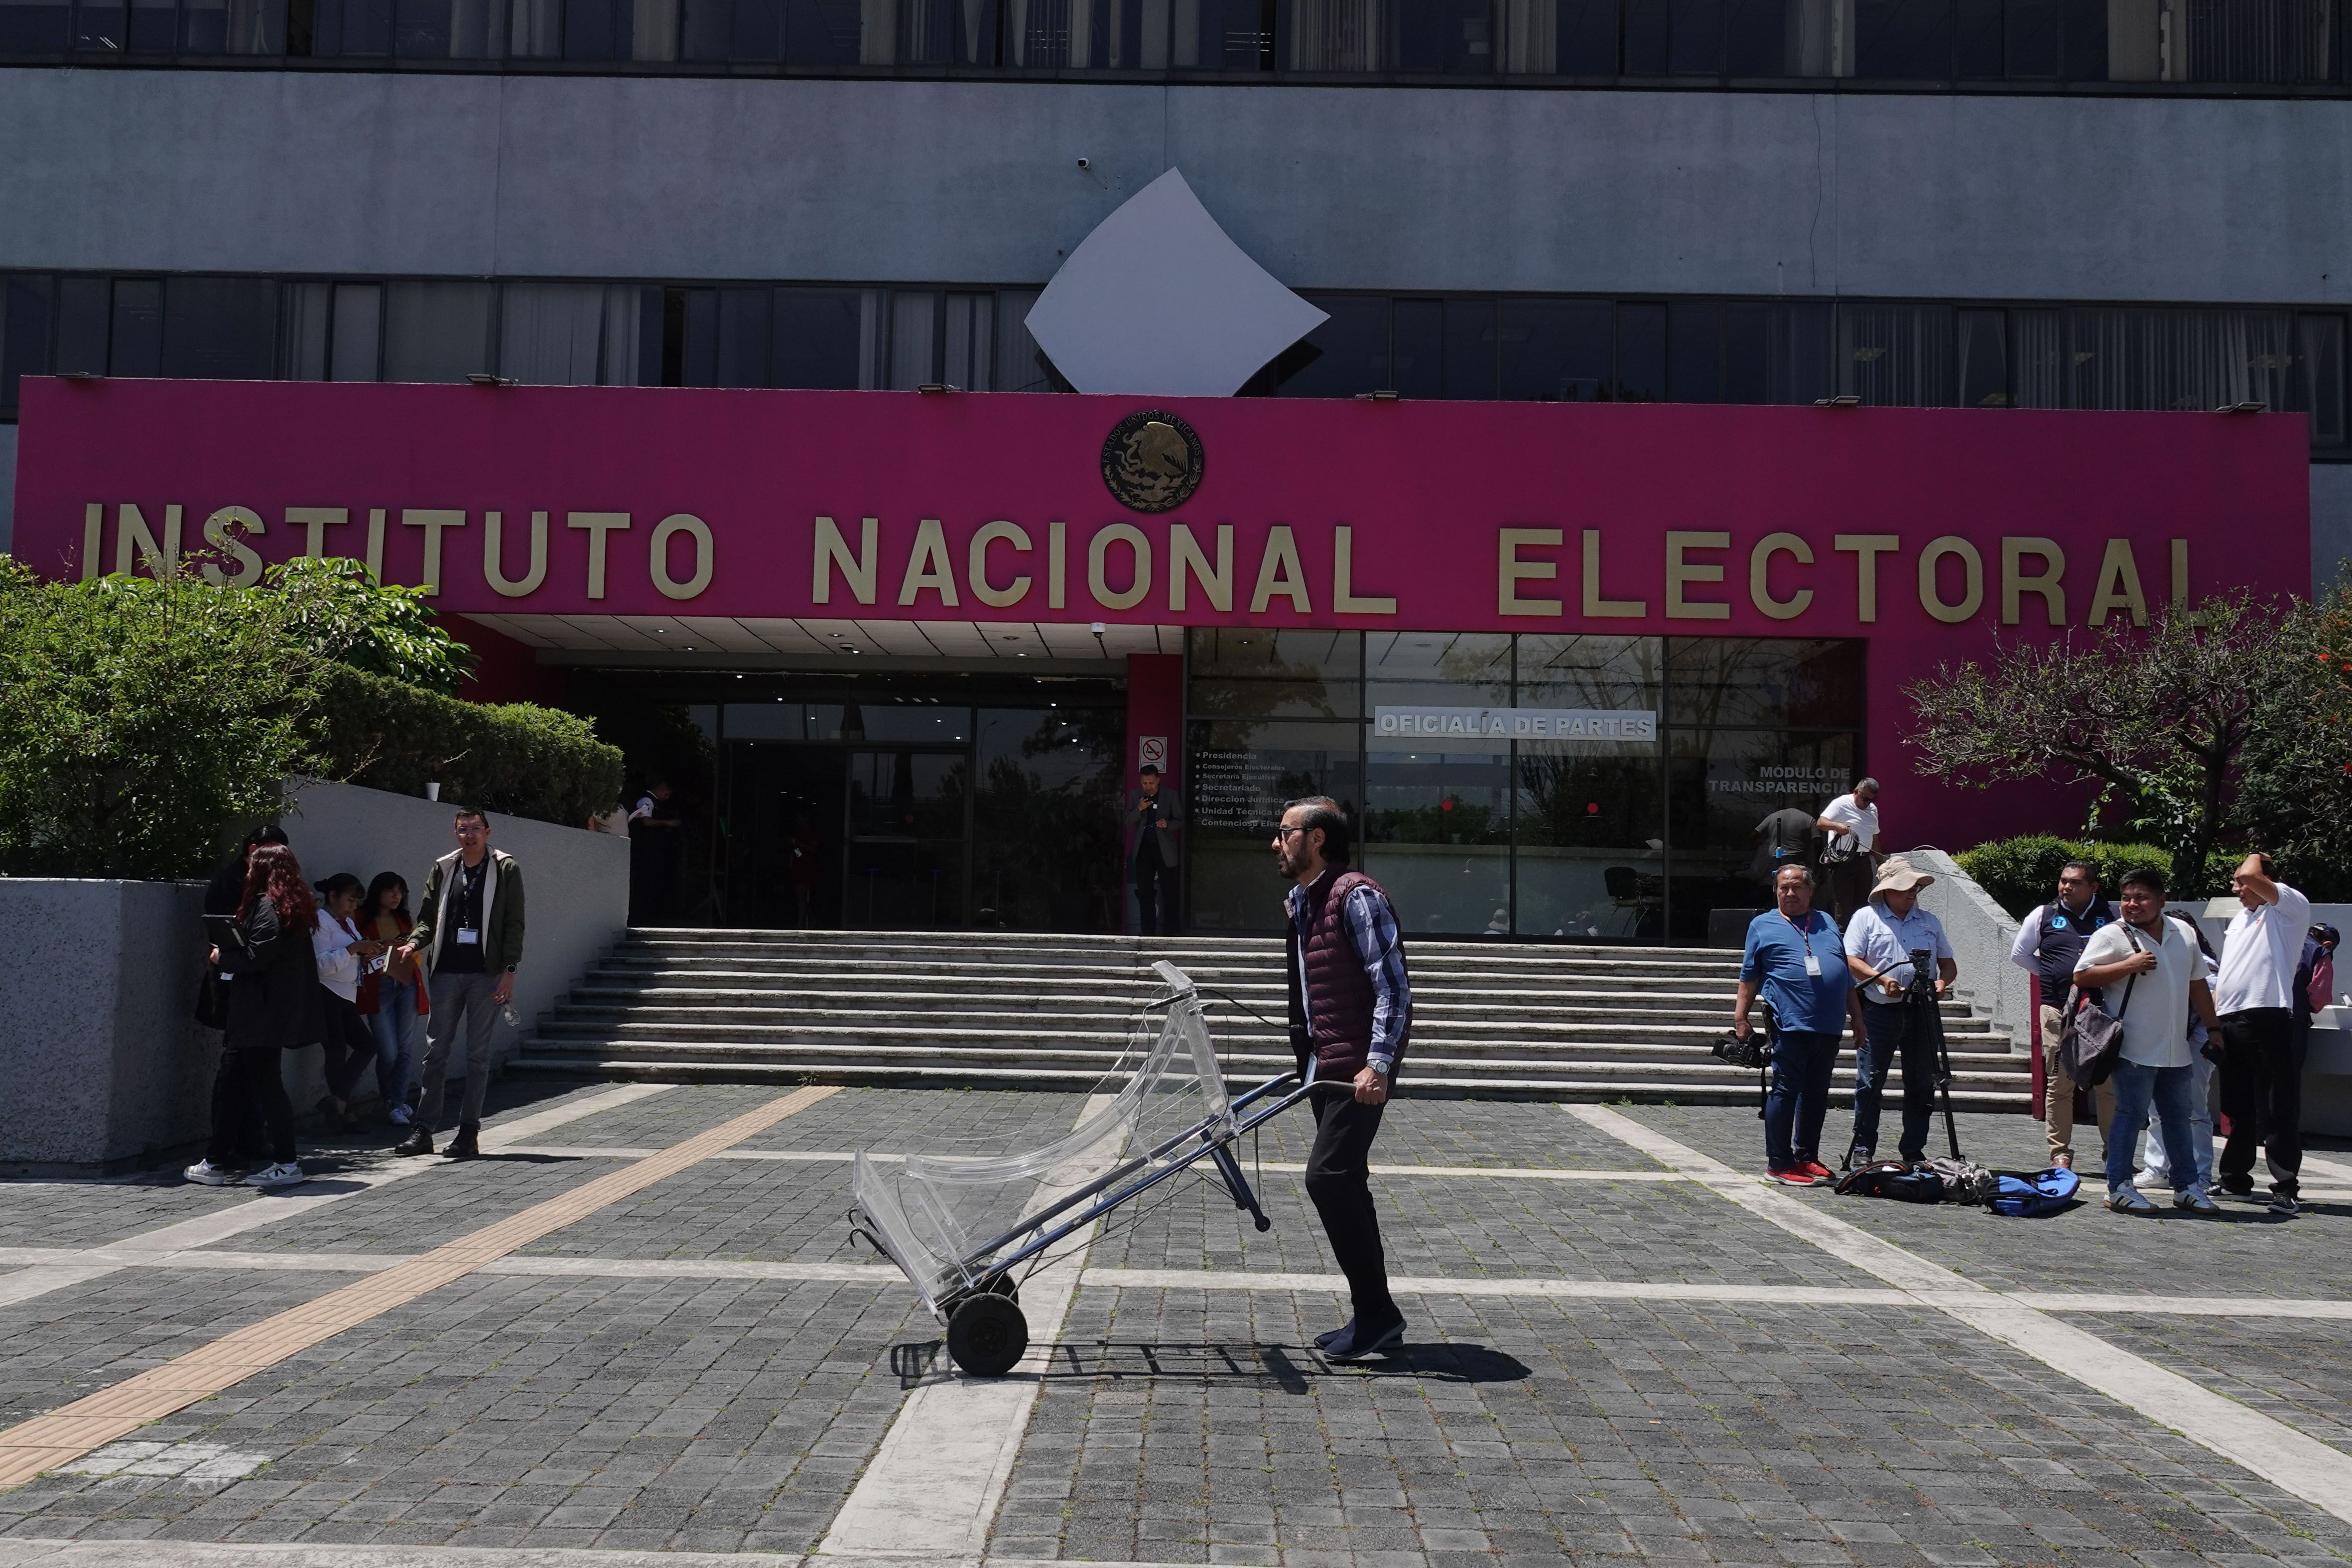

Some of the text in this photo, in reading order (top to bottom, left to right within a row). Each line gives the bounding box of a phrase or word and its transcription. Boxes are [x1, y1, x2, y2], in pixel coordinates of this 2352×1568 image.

[1102, 412, 1202, 463] ESTADOS UNIDOS MEXICANOS
[82, 503, 2210, 627] INSTITUTO NACIONAL ELECTORAL
[1380, 711, 1652, 737] OFICIALÍA DE PARTES
[1760, 765, 1850, 779] MÓDULO DE
[1708, 780, 1850, 794] TRANSPARENCIA
